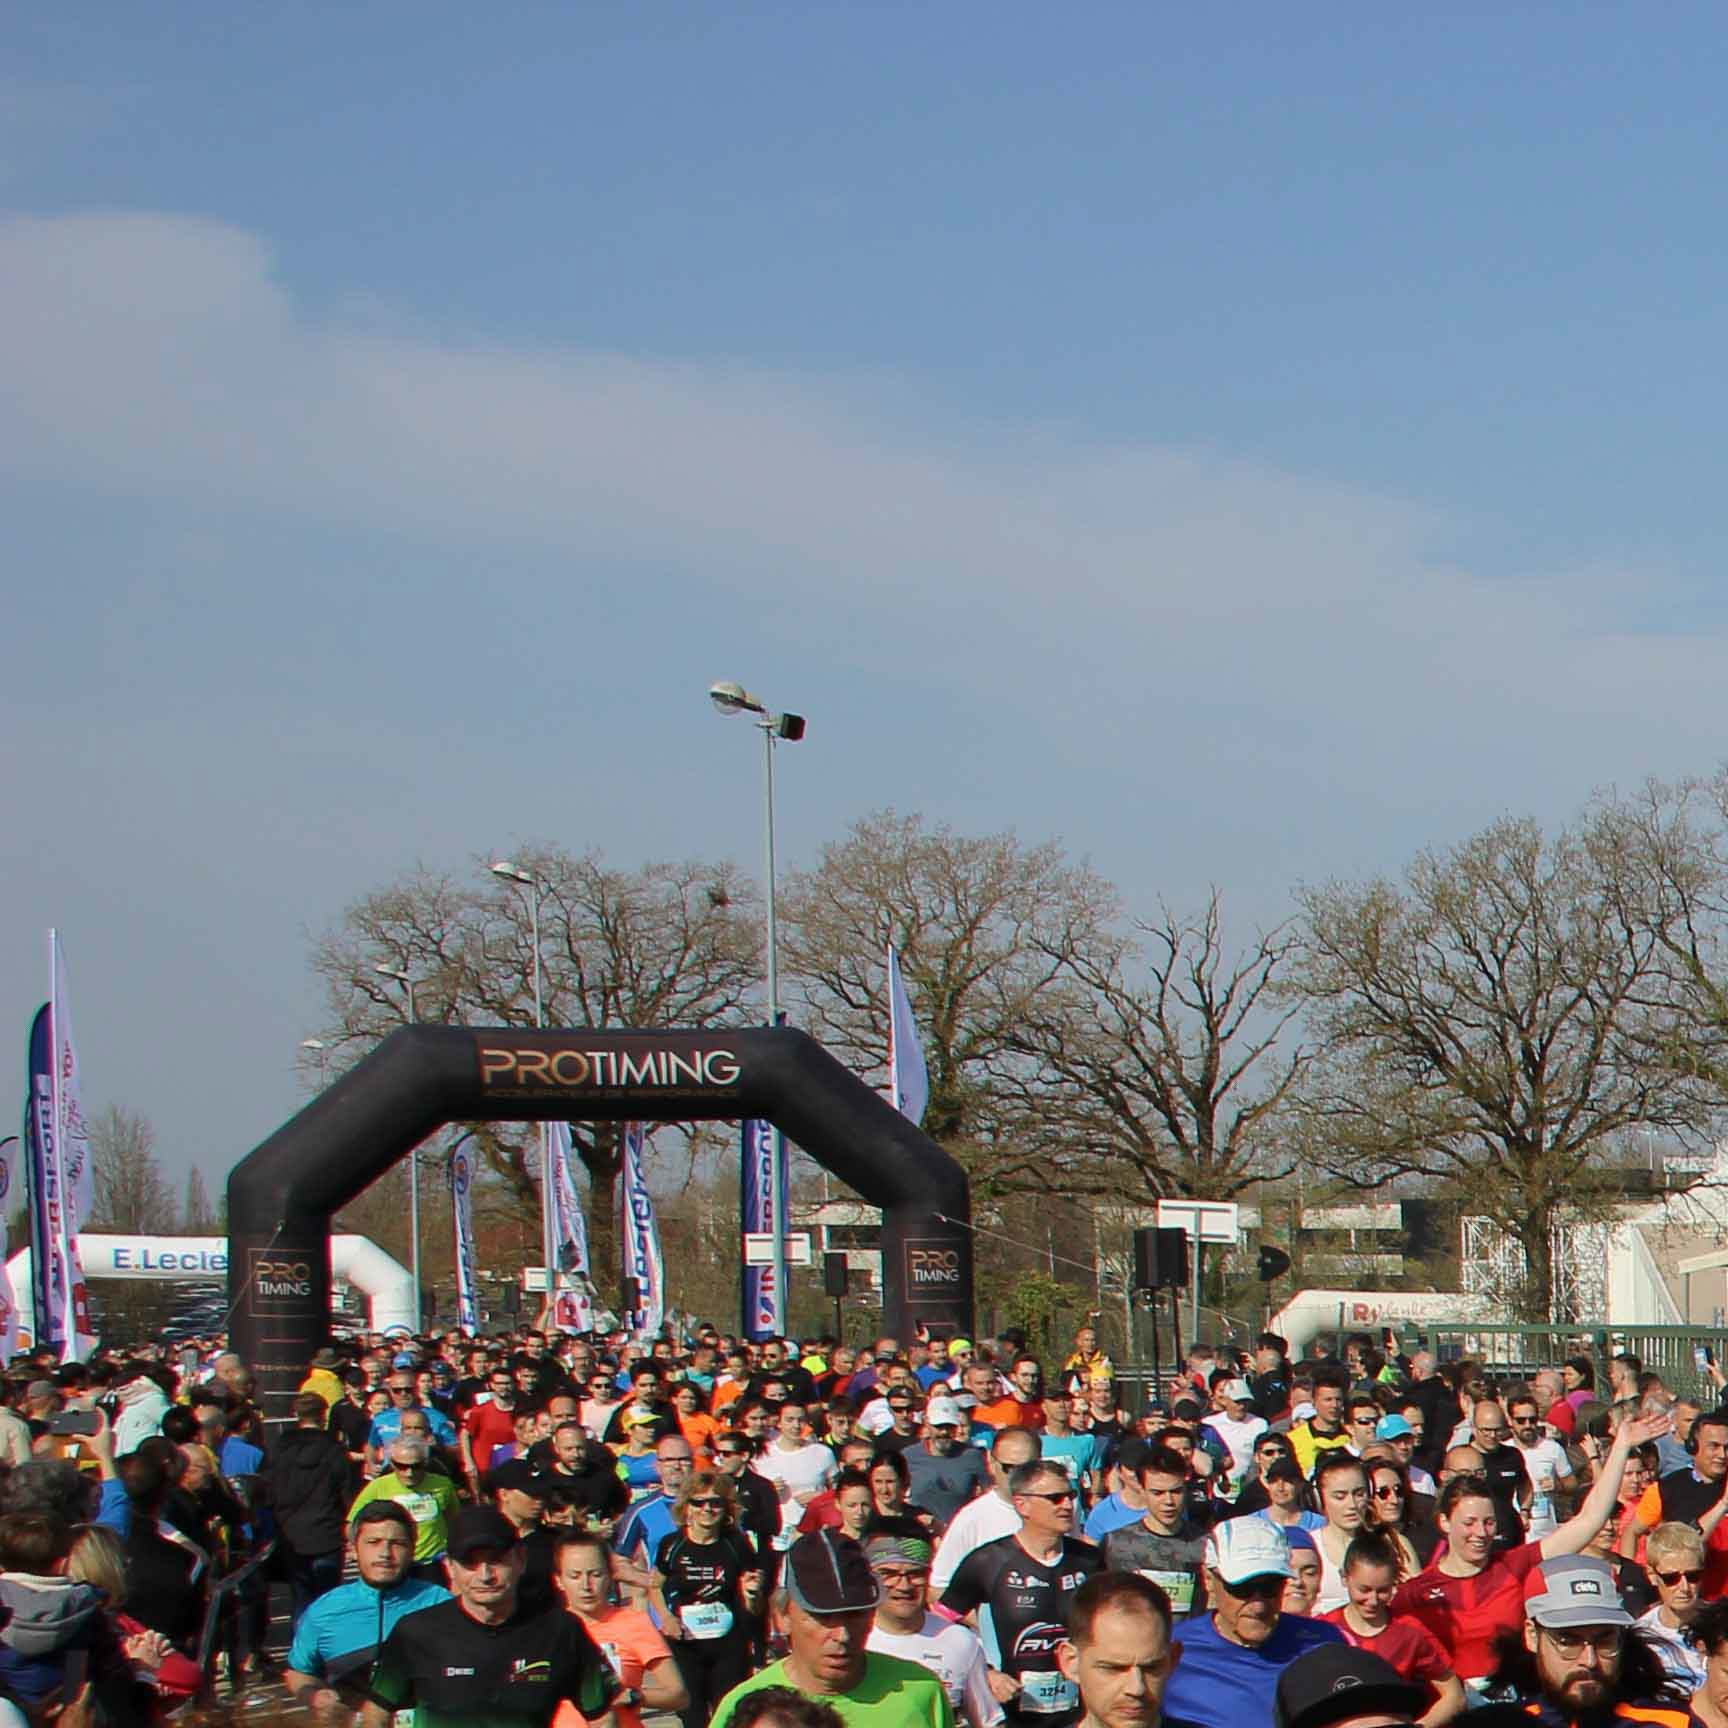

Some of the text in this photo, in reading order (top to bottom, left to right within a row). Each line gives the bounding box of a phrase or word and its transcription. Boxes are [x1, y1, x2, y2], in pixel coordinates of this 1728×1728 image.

[484, 1049, 741, 1086] PROTIMING
[113, 1248, 228, 1270] E.Lecle
[911, 1250, 960, 1269] PRO
[256, 1262, 310, 1281] PRO
[912, 1269, 960, 1282] TIMING
[257, 1281, 311, 1296] TIMING
